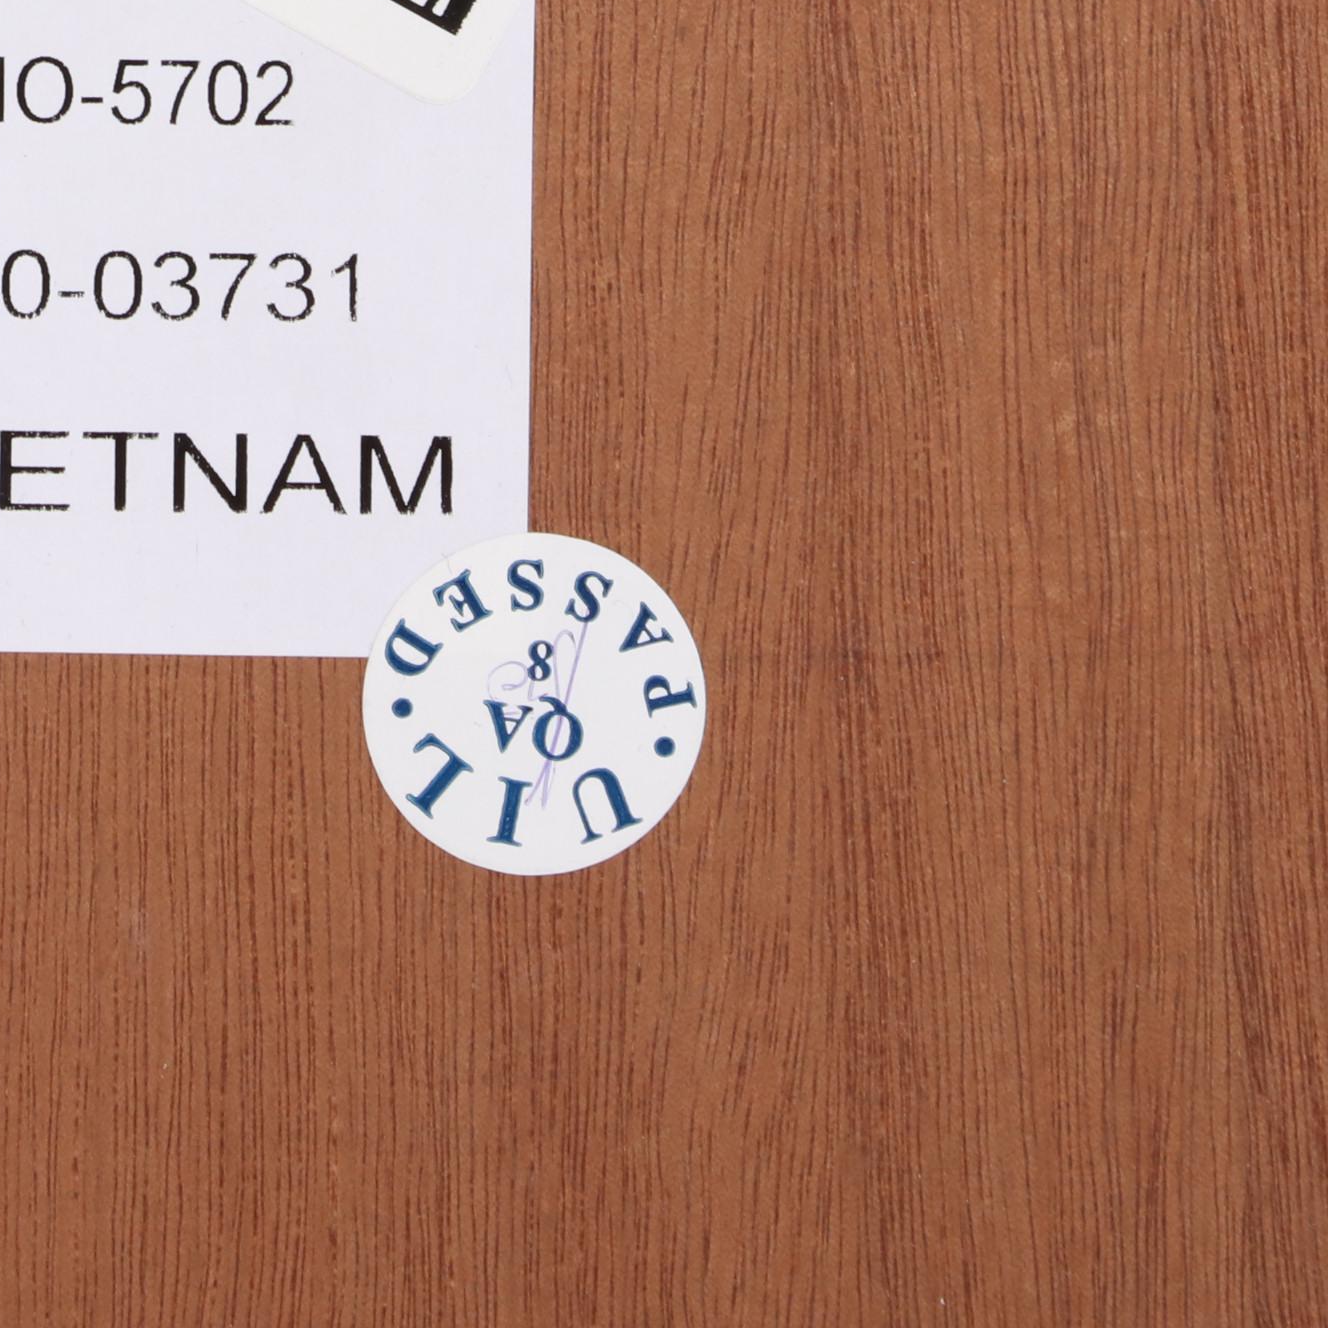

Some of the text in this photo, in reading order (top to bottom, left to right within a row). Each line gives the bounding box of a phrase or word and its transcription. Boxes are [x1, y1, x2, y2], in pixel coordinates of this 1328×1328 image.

[384, 559, 698, 719] PASSED
[527, 639, 554, 682] 8
[483, 695, 584, 762] QA
[405, 732, 644, 848] UIL
